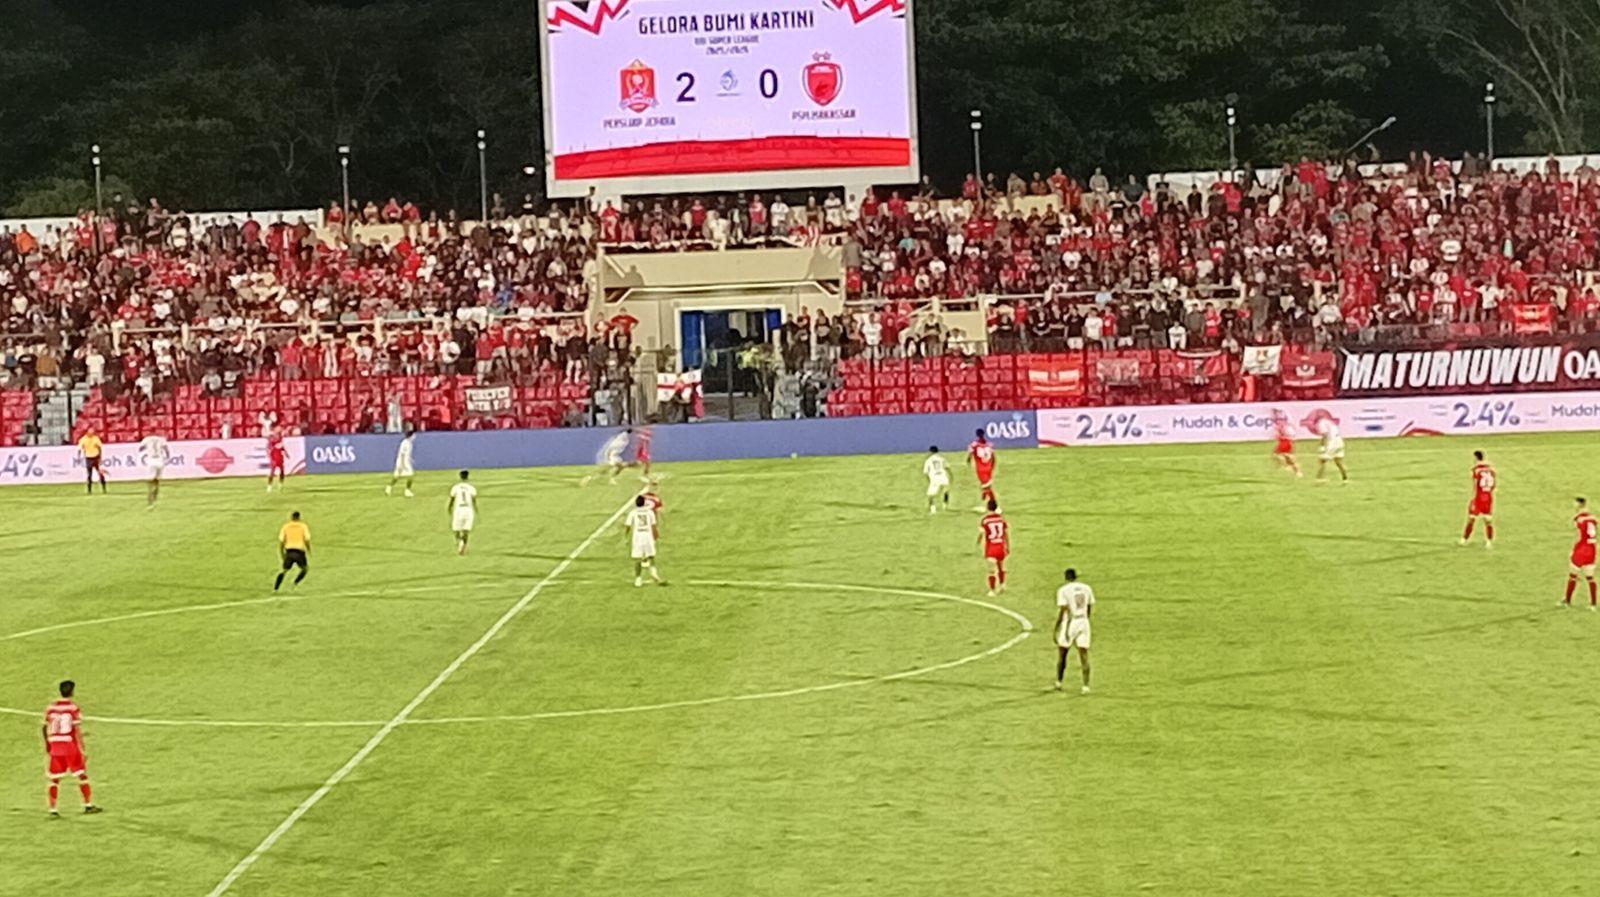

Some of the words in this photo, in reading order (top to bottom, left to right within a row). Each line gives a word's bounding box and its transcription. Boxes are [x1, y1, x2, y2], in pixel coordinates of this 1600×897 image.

[639, 15, 699, 35] GELORA
[703, 13, 745, 32] BUMI
[750, 10, 814, 30] KARTINI
[676, 72, 696, 103] 2
[759, 68, 779, 99] 0
[1340, 346, 1562, 390] MATURNUWUN
[1076, 413, 1143, 439] 2,4%
[1172, 415, 1223, 429] Mudah
[1227, 415, 1238, 428] &
[1453, 401, 1521, 428] 2,4%
[986, 420, 1031, 439] OASIS
[126, 455, 136, 467] &
[313, 446, 356, 464] OASIS
